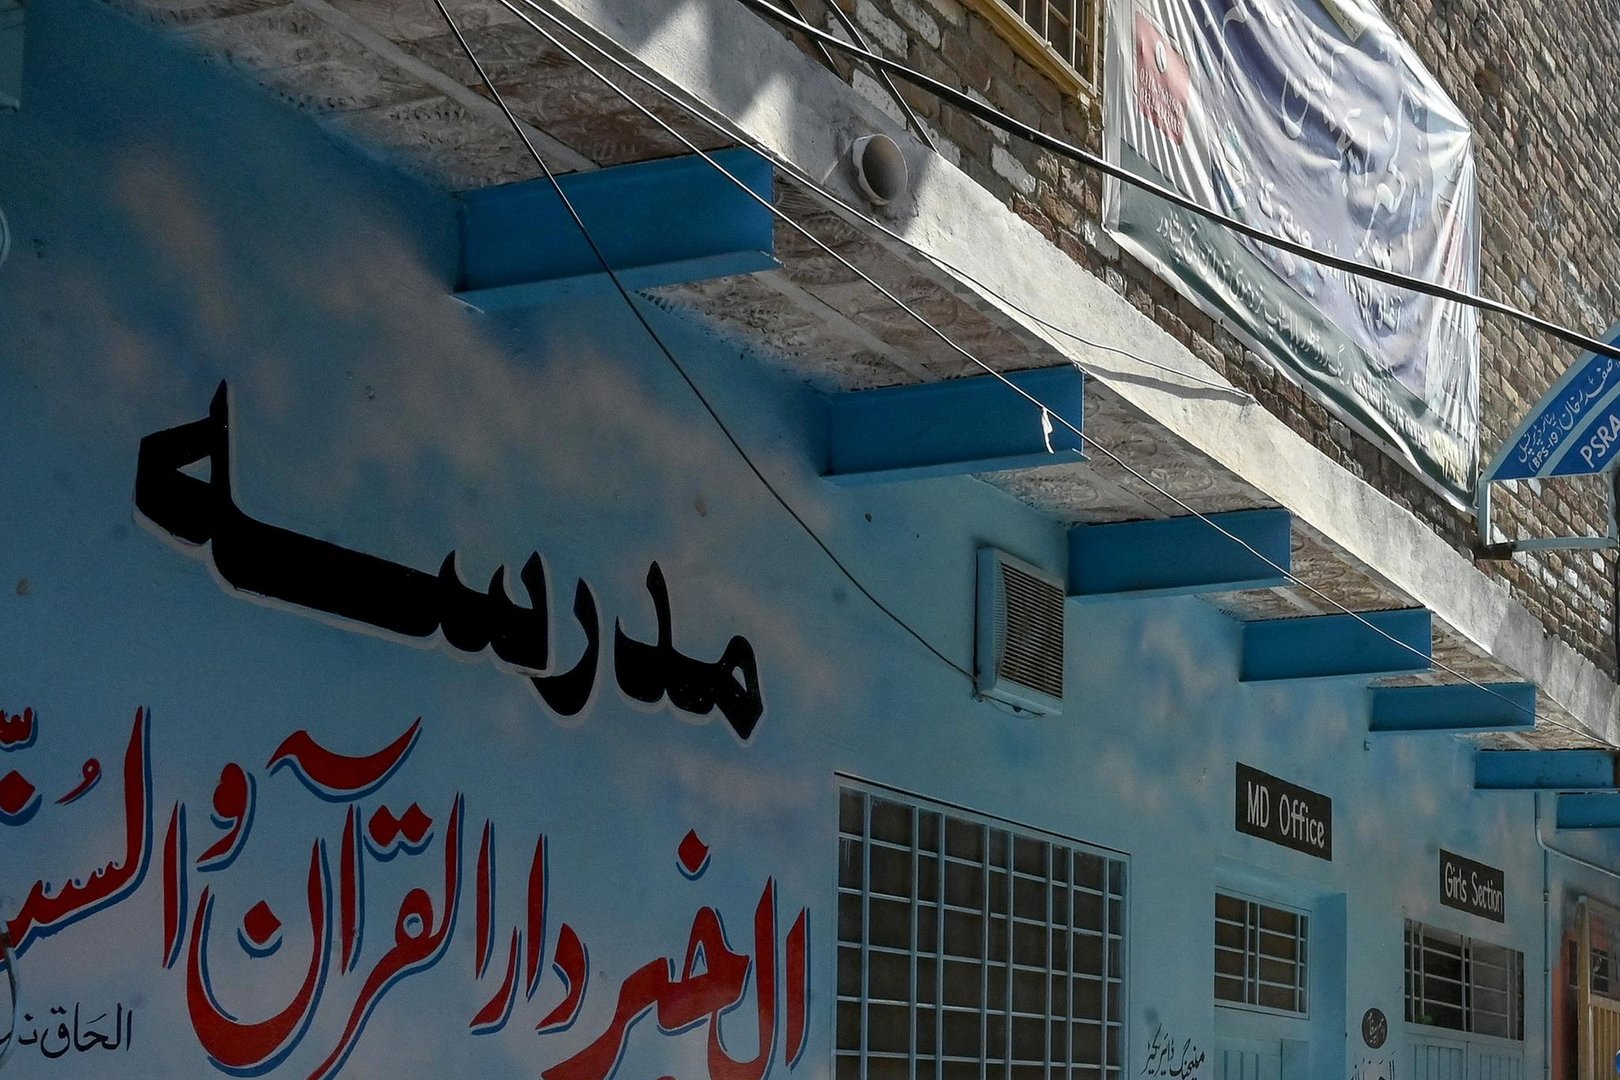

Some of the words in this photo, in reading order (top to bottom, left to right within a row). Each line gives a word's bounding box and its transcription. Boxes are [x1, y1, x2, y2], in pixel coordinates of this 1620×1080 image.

[135, 377, 765, 743] مدرسہ
[1247, 780, 1270, 829] MD
[1278, 793, 1325, 849] Office
[1444, 861, 1467, 904] Girls
[1471, 870, 1504, 914] Section
